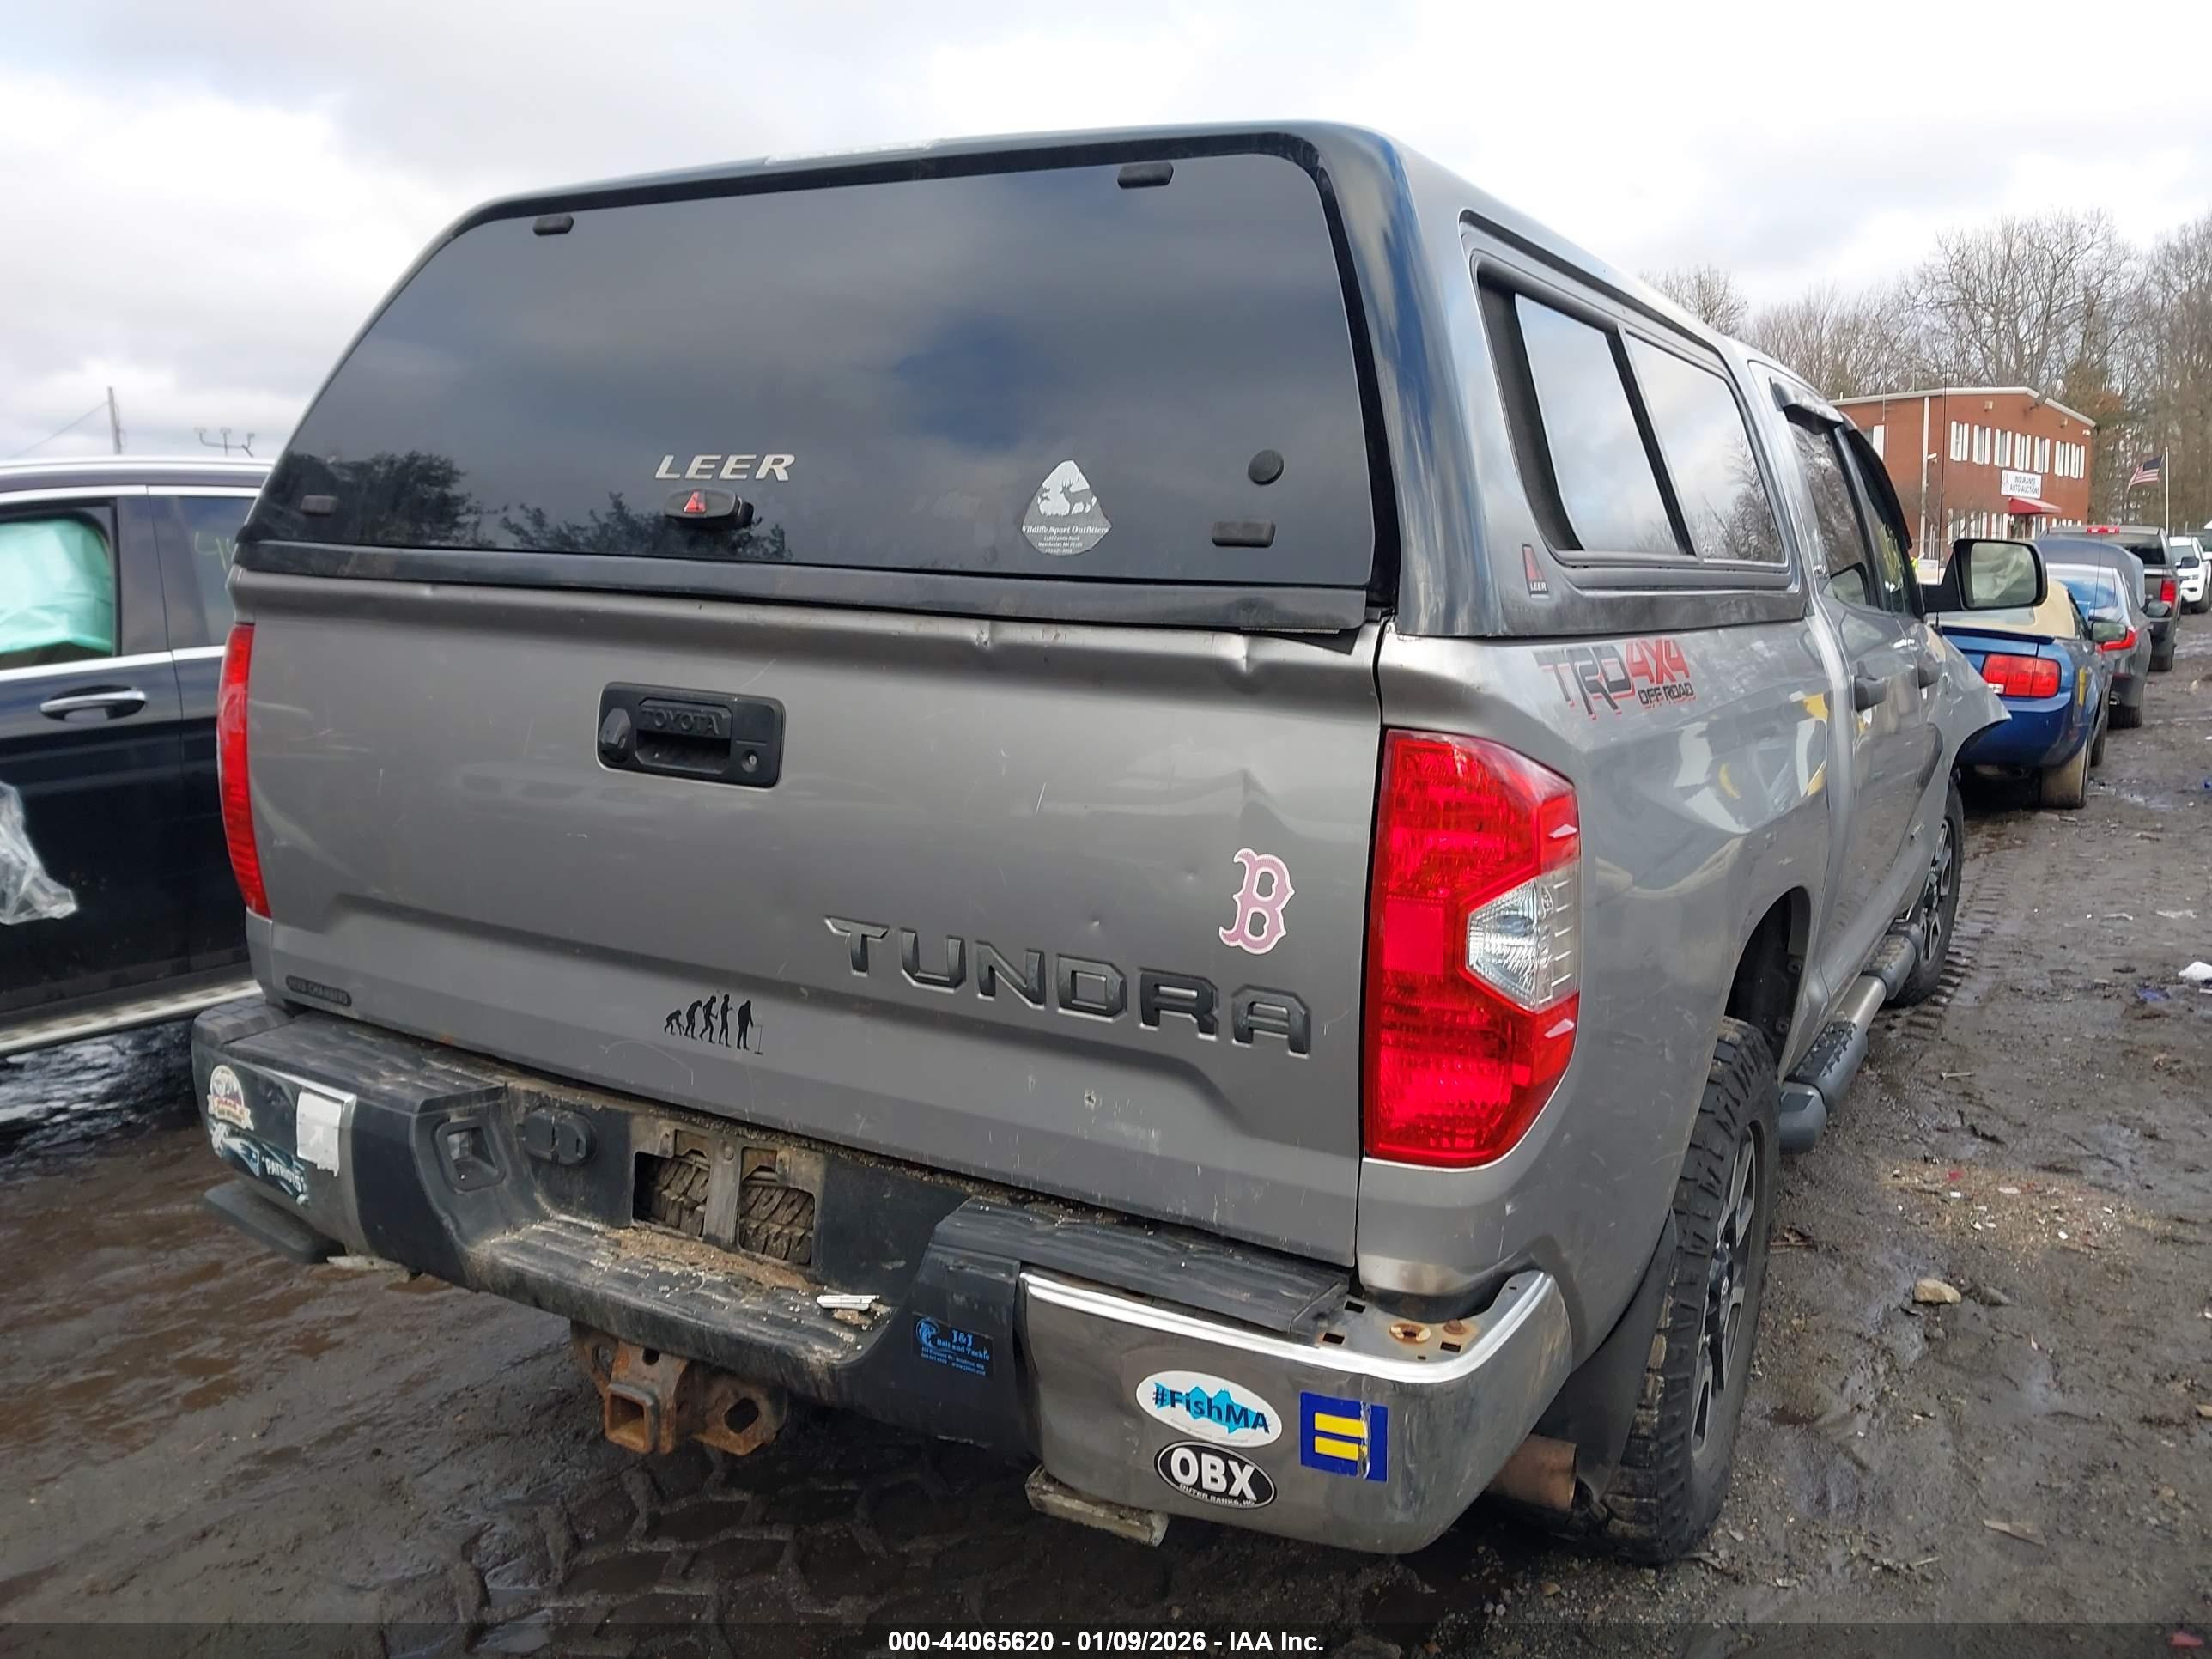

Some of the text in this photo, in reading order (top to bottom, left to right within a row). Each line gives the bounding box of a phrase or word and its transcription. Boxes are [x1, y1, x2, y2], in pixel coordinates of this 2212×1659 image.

[655, 453, 796, 482] LEER
[1530, 581, 1547, 592] LEER
[1532, 645, 1634, 719] TRD
[1638, 682, 1694, 707] OFF ROAD
[641, 707, 720, 736] TOYOTA
[1219, 848, 1295, 955] B
[823, 915, 1311, 1058] TUNDRA
[1152, 1386, 1270, 1434] #FishMA
[1170, 1447, 1257, 1502] OBX
